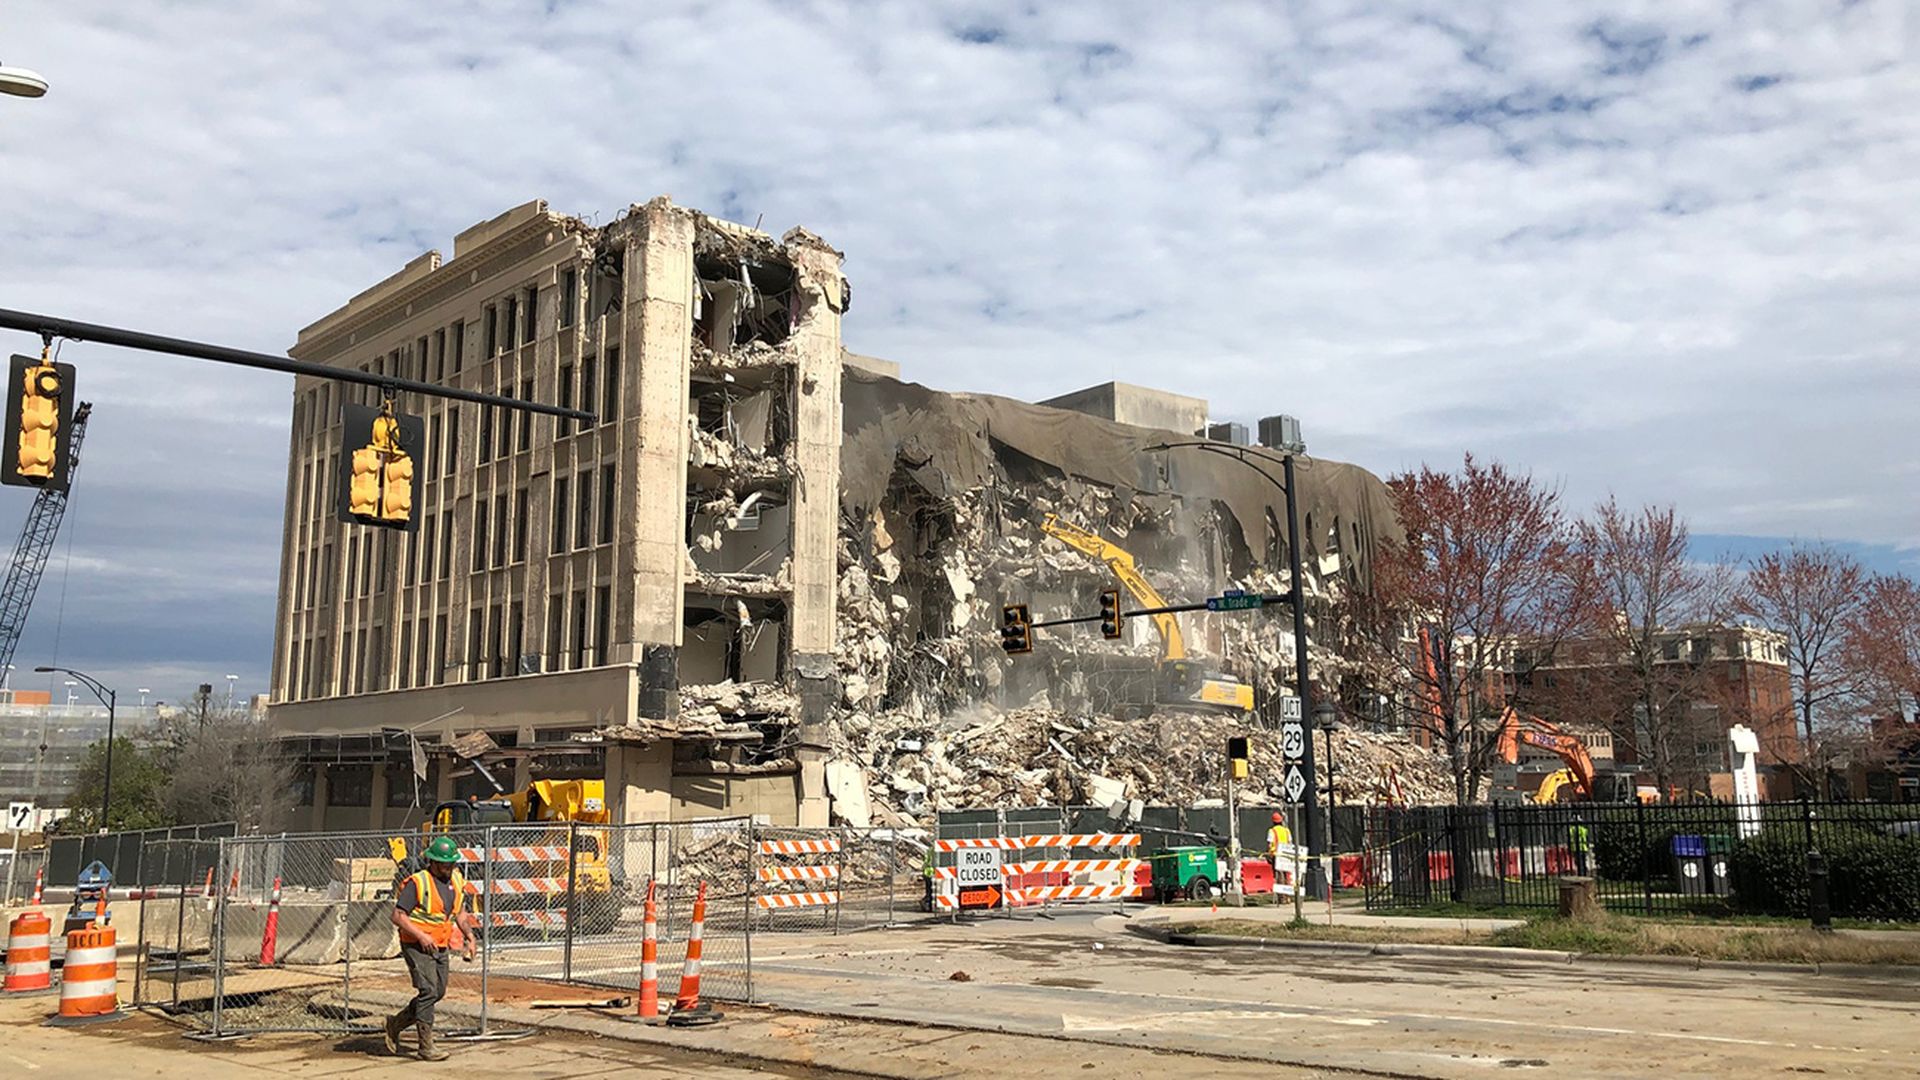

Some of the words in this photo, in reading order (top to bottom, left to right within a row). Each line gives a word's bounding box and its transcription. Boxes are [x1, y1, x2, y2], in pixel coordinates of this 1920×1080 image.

[1284, 699, 1300, 716] JCT
[1285, 731, 1301, 751] 29
[1289, 775, 1301, 792] 49
[966, 852, 993, 865] ROAD
[960, 868, 998, 881] CLOSED
[963, 892, 991, 904] DETOUR
